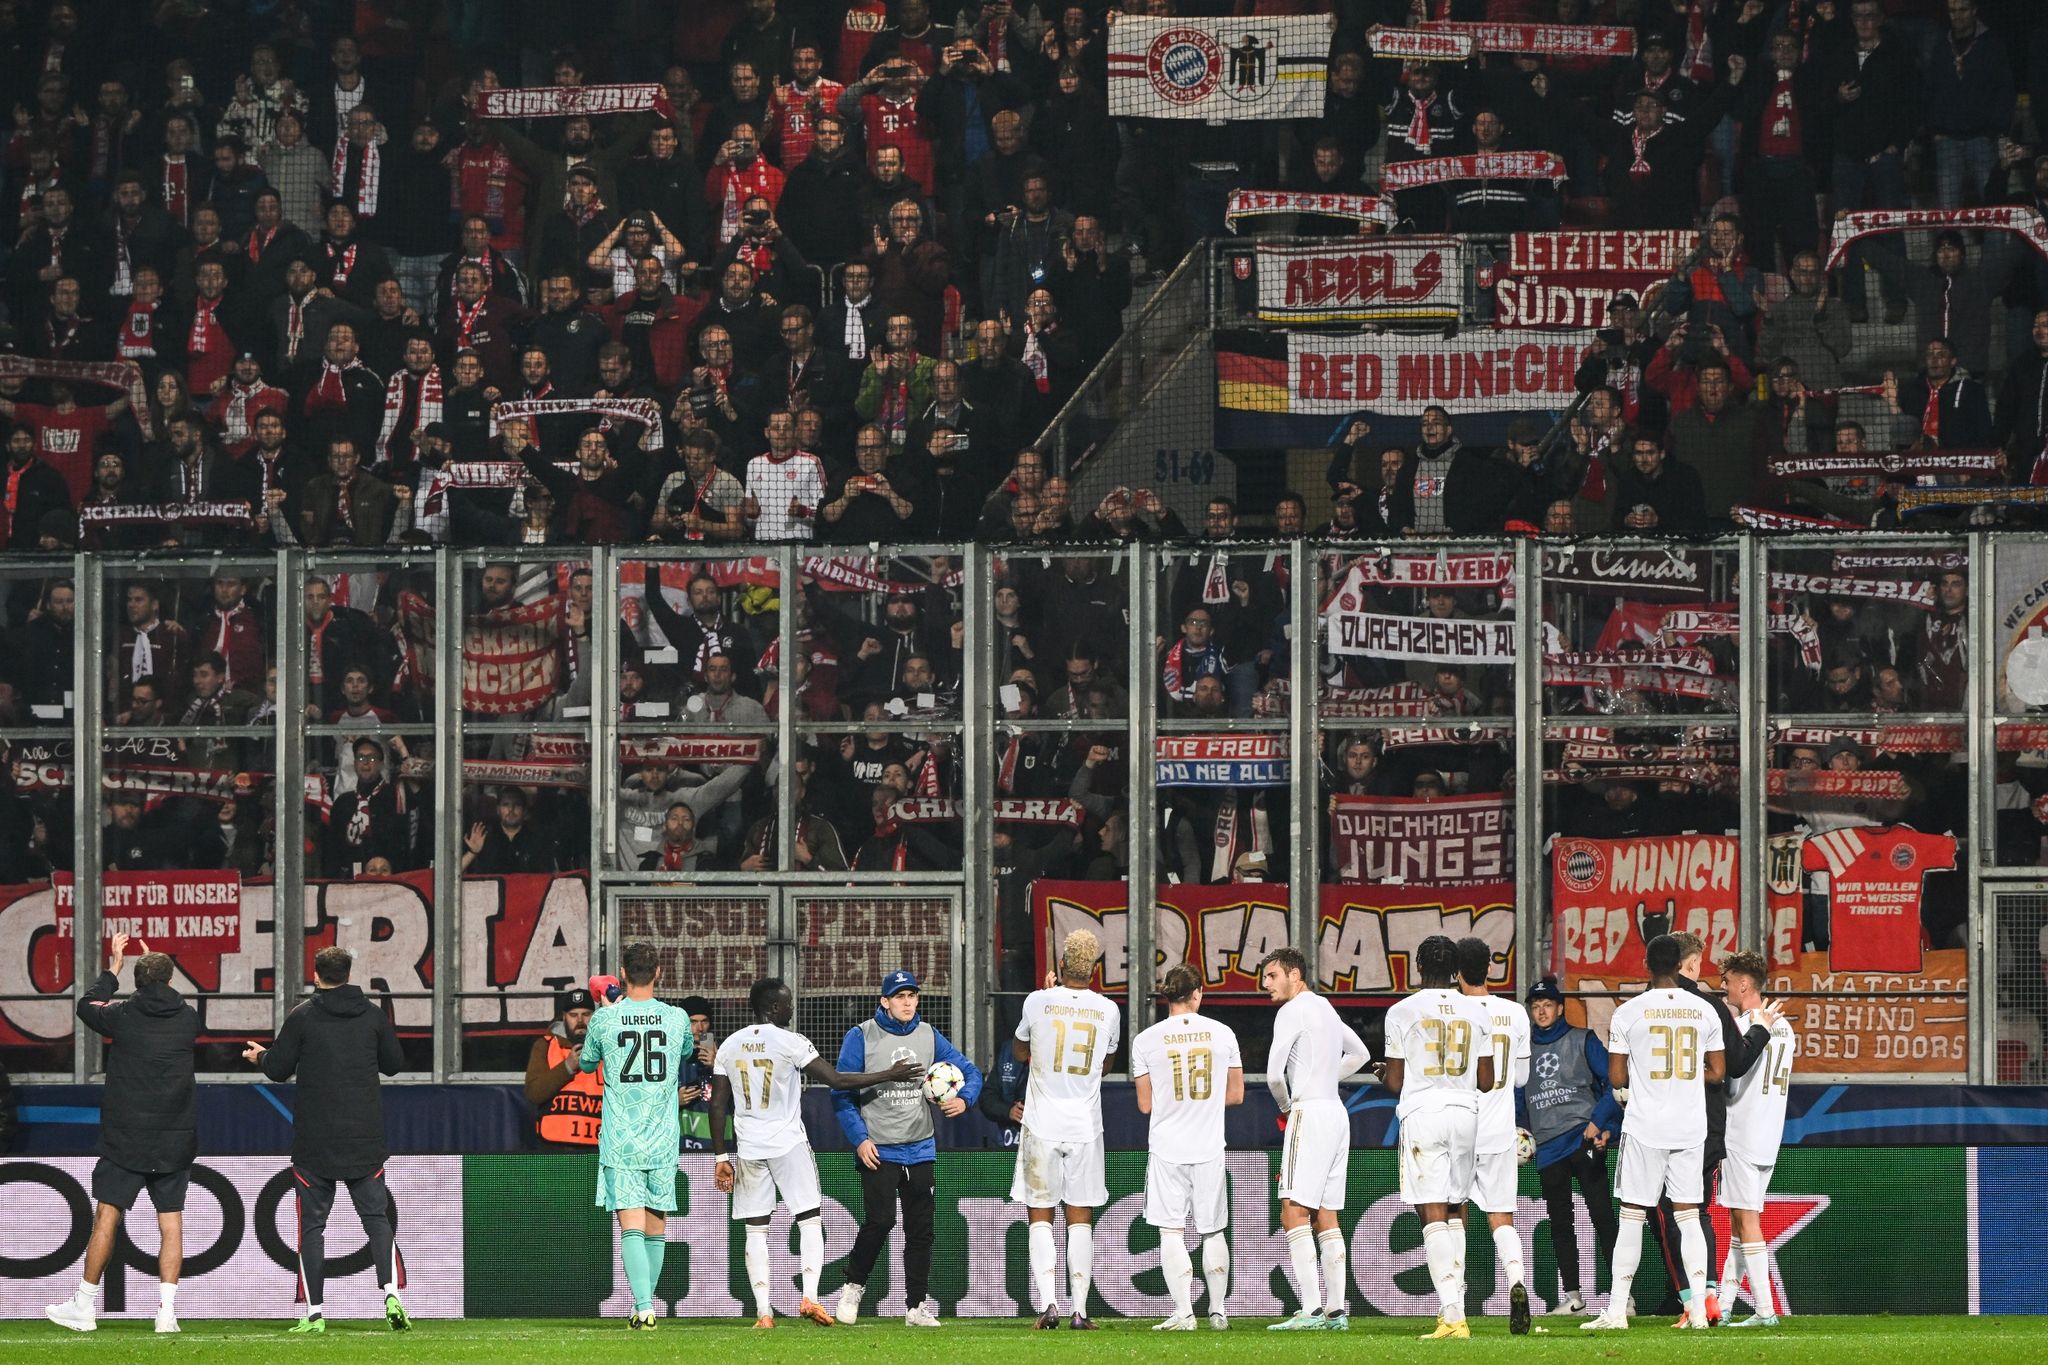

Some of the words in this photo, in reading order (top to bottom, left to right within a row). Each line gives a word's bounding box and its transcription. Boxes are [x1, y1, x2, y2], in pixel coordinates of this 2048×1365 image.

[1168, 33, 1218, 60] BAYERN
[1905, 208, 2010, 226] BAYERN
[1511, 232, 1616, 272] LETZTE
[1285, 250, 1443, 307] REBELS
[1299, 352, 1382, 401] RED
[1774, 457, 1878, 476] SCHICKERIA
[1835, 554, 1934, 569] CHICKERIA
[805, 556, 888, 593] FOREVER
[2003, 606, 2027, 630] WE
[1340, 614, 1487, 656] DURCHZIEHEN
[490, 766, 560, 778] MÜNCHEN
[1610, 839, 1736, 895] MUNICH
[136, 881, 169, 906] FÜR
[173, 883, 238, 905] UNSERE
[1836, 882, 1860, 891] WIR
[1865, 881, 1918, 891] WOLLEN
[1836, 893, 1916, 903] ROT-WEISSE
[1849, 905, 1903, 915] TRIKOTS
[147, 916, 169, 938] IM
[175, 915, 238, 938] KNAST
[1562, 906, 1630, 966] RED
[621, 1015, 662, 1026] ULREICH
[1044, 1005, 1105, 1021] CHOUPO-MOTING
[1438, 1005, 1456, 1015] TEL
[1644, 1009, 1702, 1021] GRAVENBERCH
[1804, 1004, 1916, 1032] BEHIND
[1052, 1020, 1097, 1076] 13
[1163, 1031, 1212, 1045] SABITZER
[1421, 1018, 1472, 1077] 39
[1873, 1035, 1966, 1061] DOORS
[617, 1030, 667, 1083] 26
[1649, 1025, 1697, 1081] 38
[1167, 1047, 1213, 1101] 18
[1763, 1042, 1790, 1097] 14
[735, 1059, 774, 1110] 17
[1529, 1086, 1579, 1105] CHAMPIONS
[1539, 1079, 1559, 1091] UEFA
[890, 1098, 921, 1107] LEAGUE
[1535, 1096, 1571, 1110] LEAGUE
[600, 1151, 1606, 1317] Heineken
